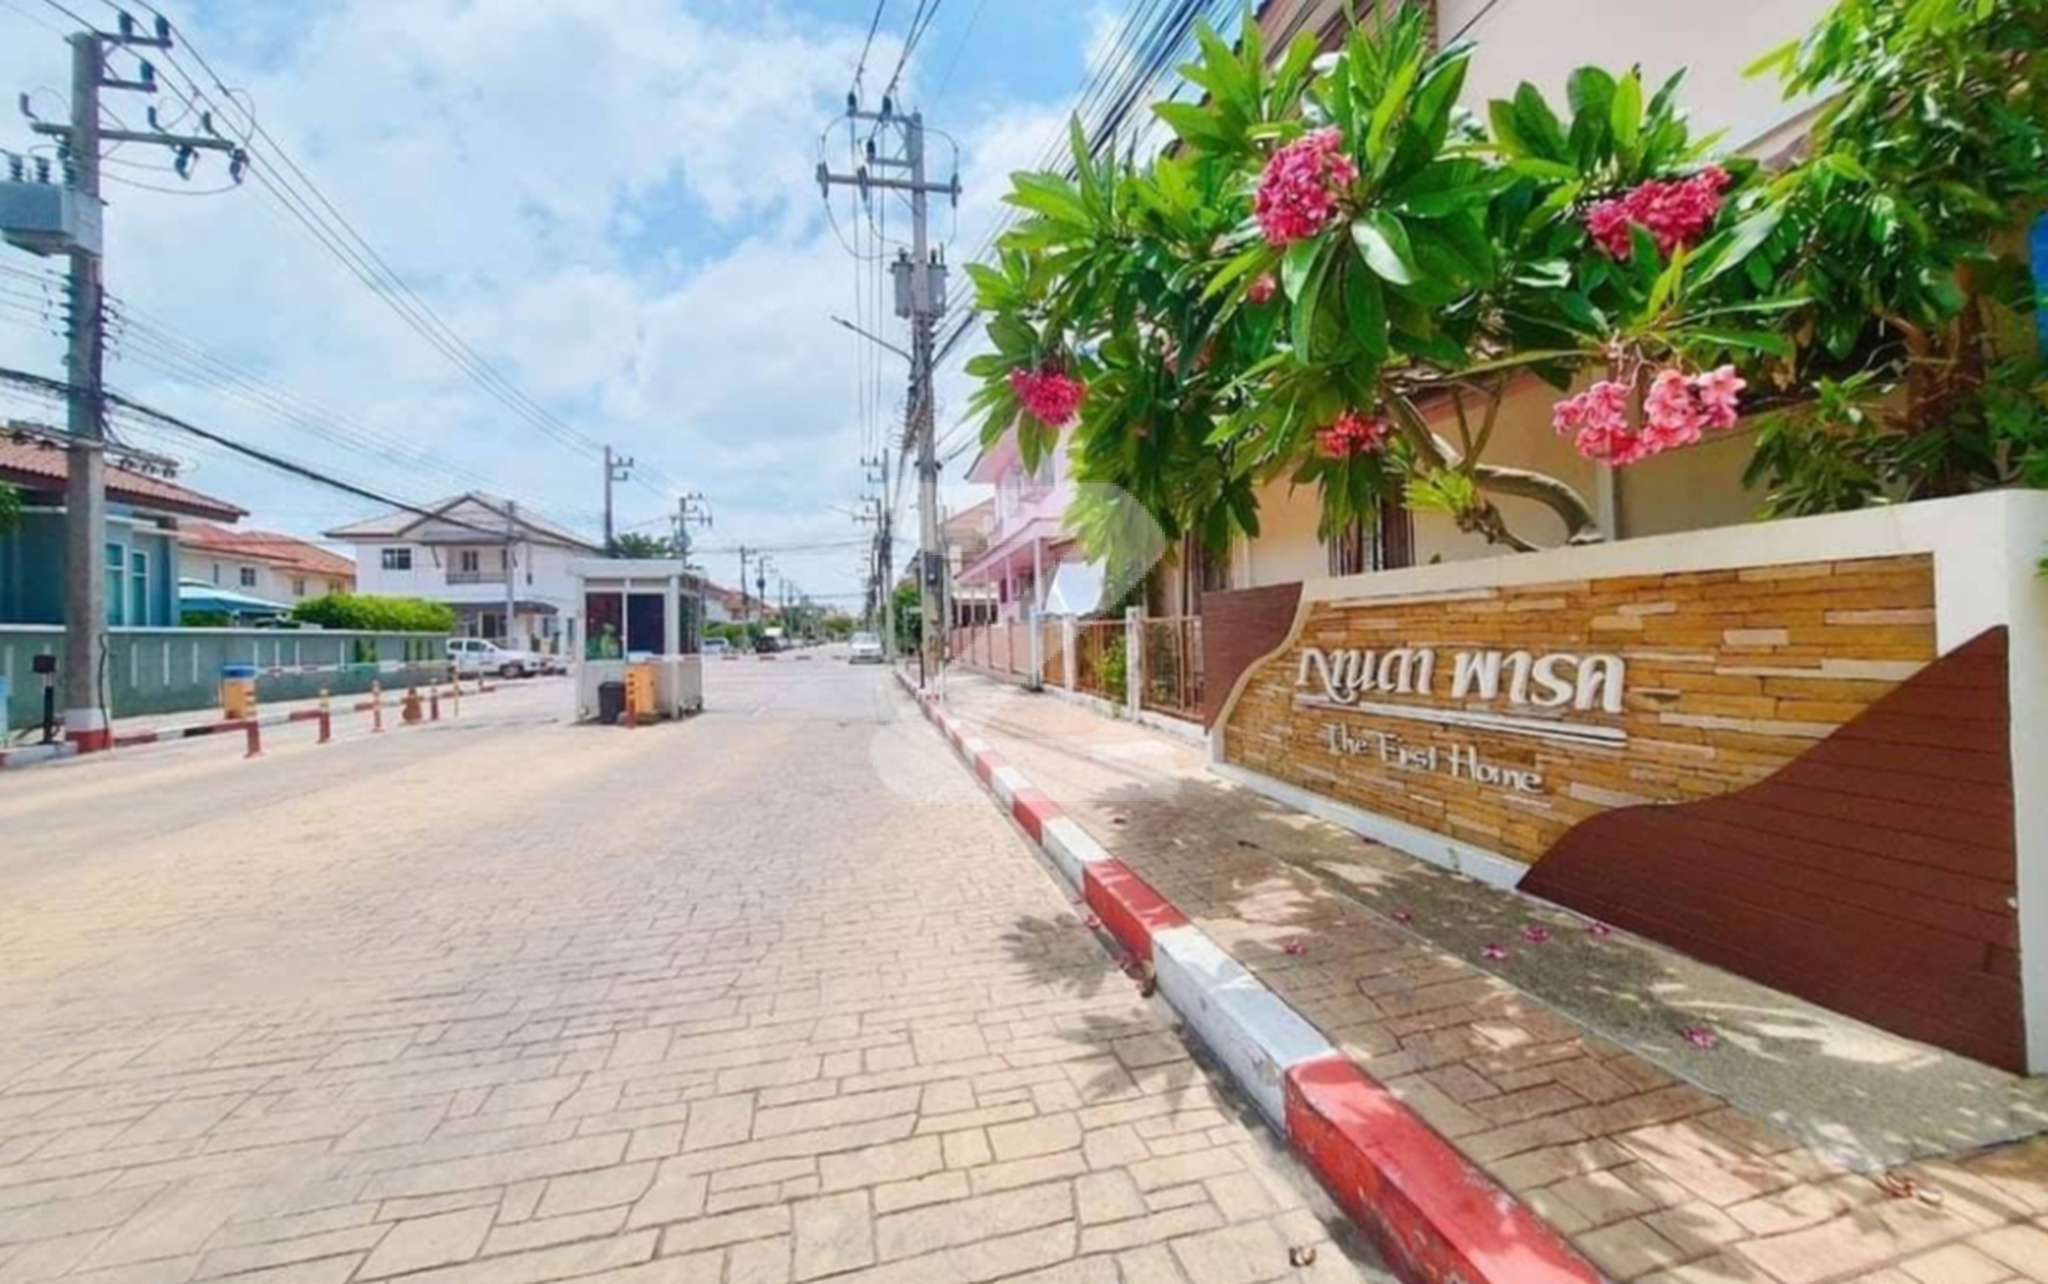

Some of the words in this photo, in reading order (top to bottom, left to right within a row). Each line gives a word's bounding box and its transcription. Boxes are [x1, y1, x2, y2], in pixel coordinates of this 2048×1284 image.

[1323, 722, 1368, 755] The
[1374, 730, 1437, 771] First
[1448, 743, 1542, 793] Home
